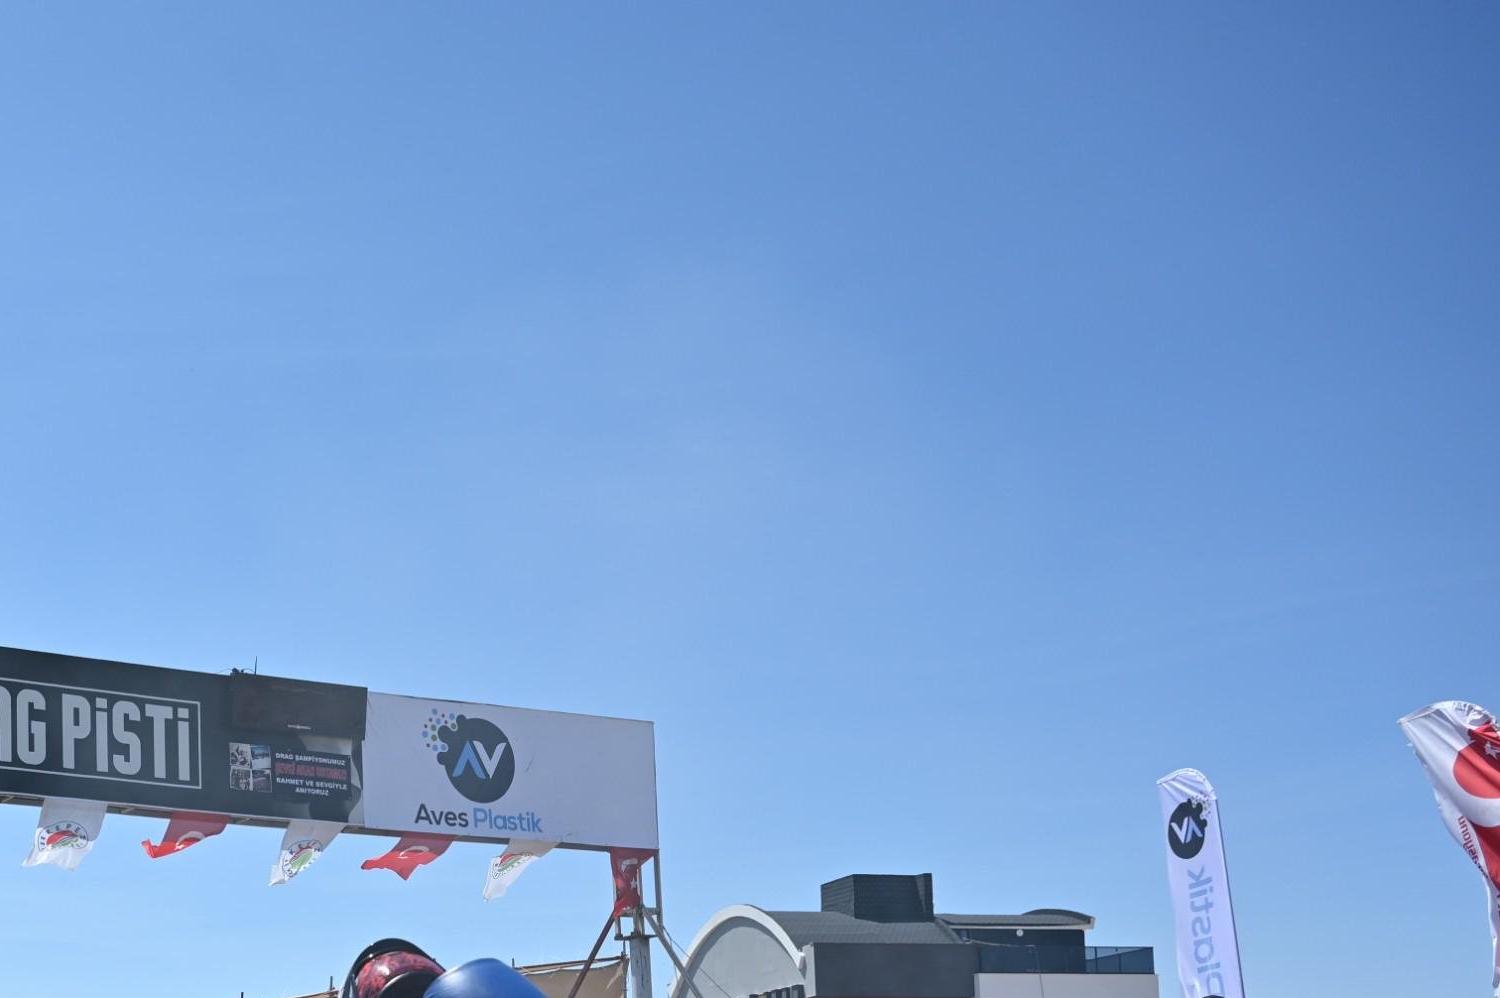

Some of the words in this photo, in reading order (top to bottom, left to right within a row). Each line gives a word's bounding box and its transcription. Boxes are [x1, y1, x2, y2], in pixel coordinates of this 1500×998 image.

[61, 693, 191, 782] PİSTİ
[414, 803, 470, 829] Aves
[472, 807, 544, 834] Plastik
